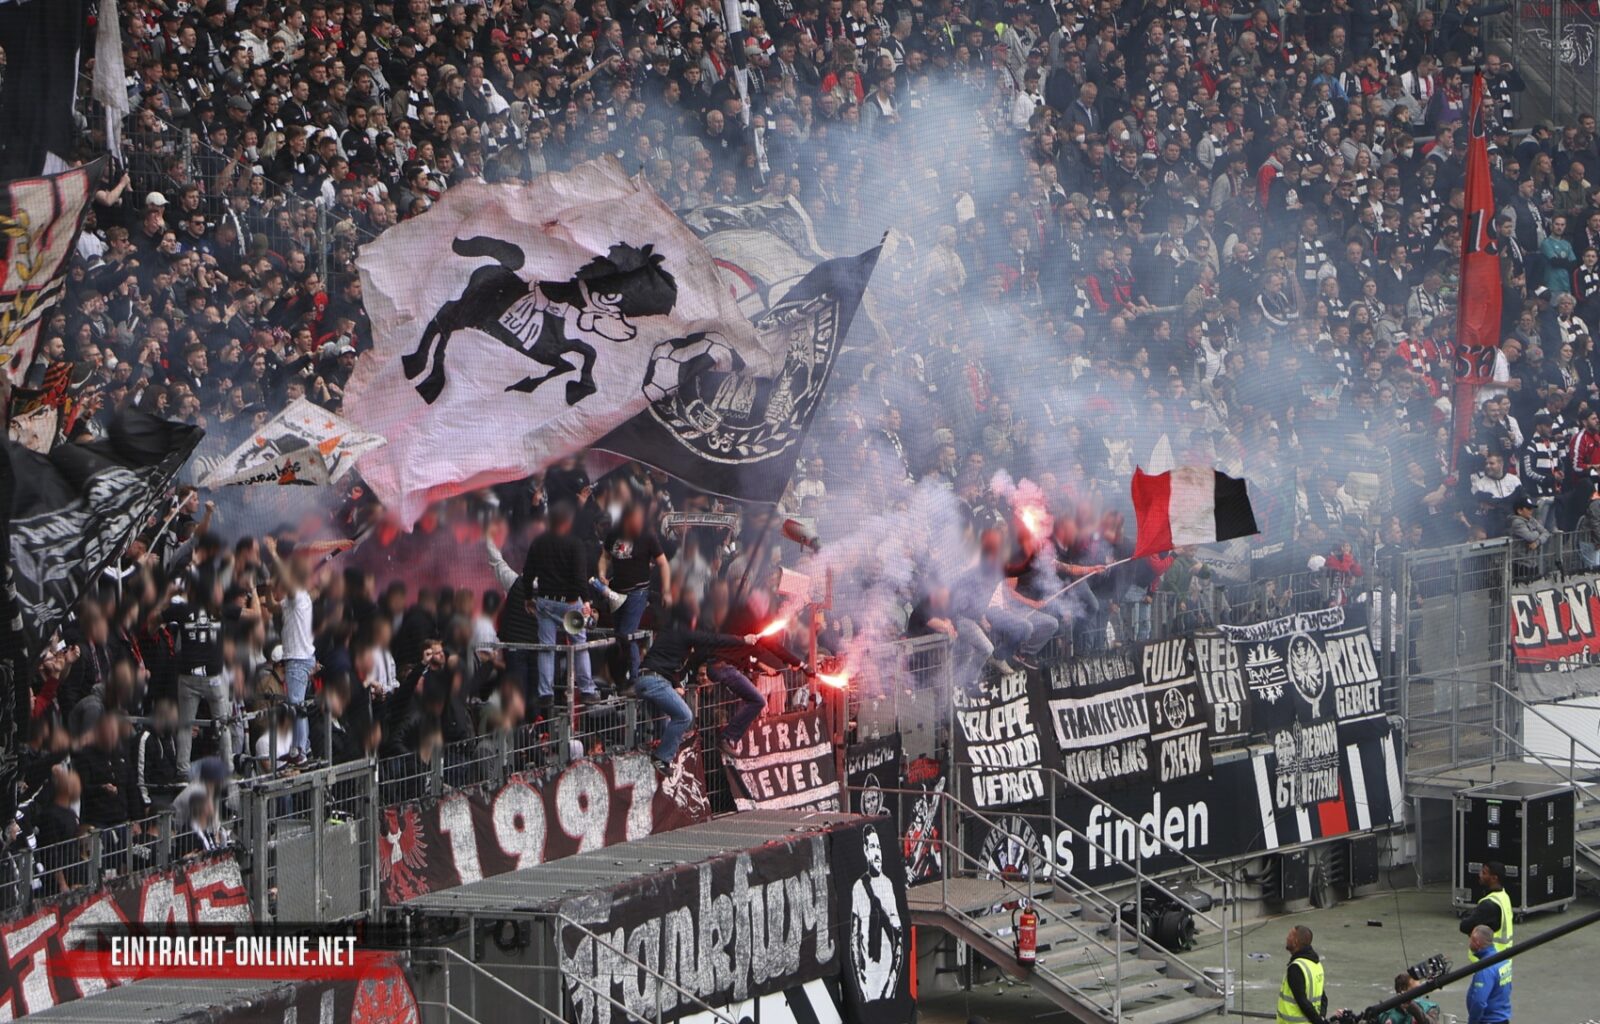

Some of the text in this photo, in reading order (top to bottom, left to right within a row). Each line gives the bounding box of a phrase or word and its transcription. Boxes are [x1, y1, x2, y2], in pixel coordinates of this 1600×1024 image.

[1511, 580, 1600, 645] EIN
[1324, 633, 1378, 686] RIED
[956, 696, 1034, 742] GRUPPE
[1057, 692, 1148, 740] FRANKFURT
[1214, 702, 1242, 733] 64
[1335, 680, 1382, 718] GEBIET
[967, 733, 1041, 774] STADION
[1065, 738, 1149, 785] HOOLIGANS
[1161, 732, 1201, 783] CREW
[1301, 720, 1339, 759] REGION
[740, 761, 824, 801] NEVER
[972, 764, 1045, 807] VERBOT
[439, 751, 659, 886] 1997
[1086, 792, 1208, 871] finden
